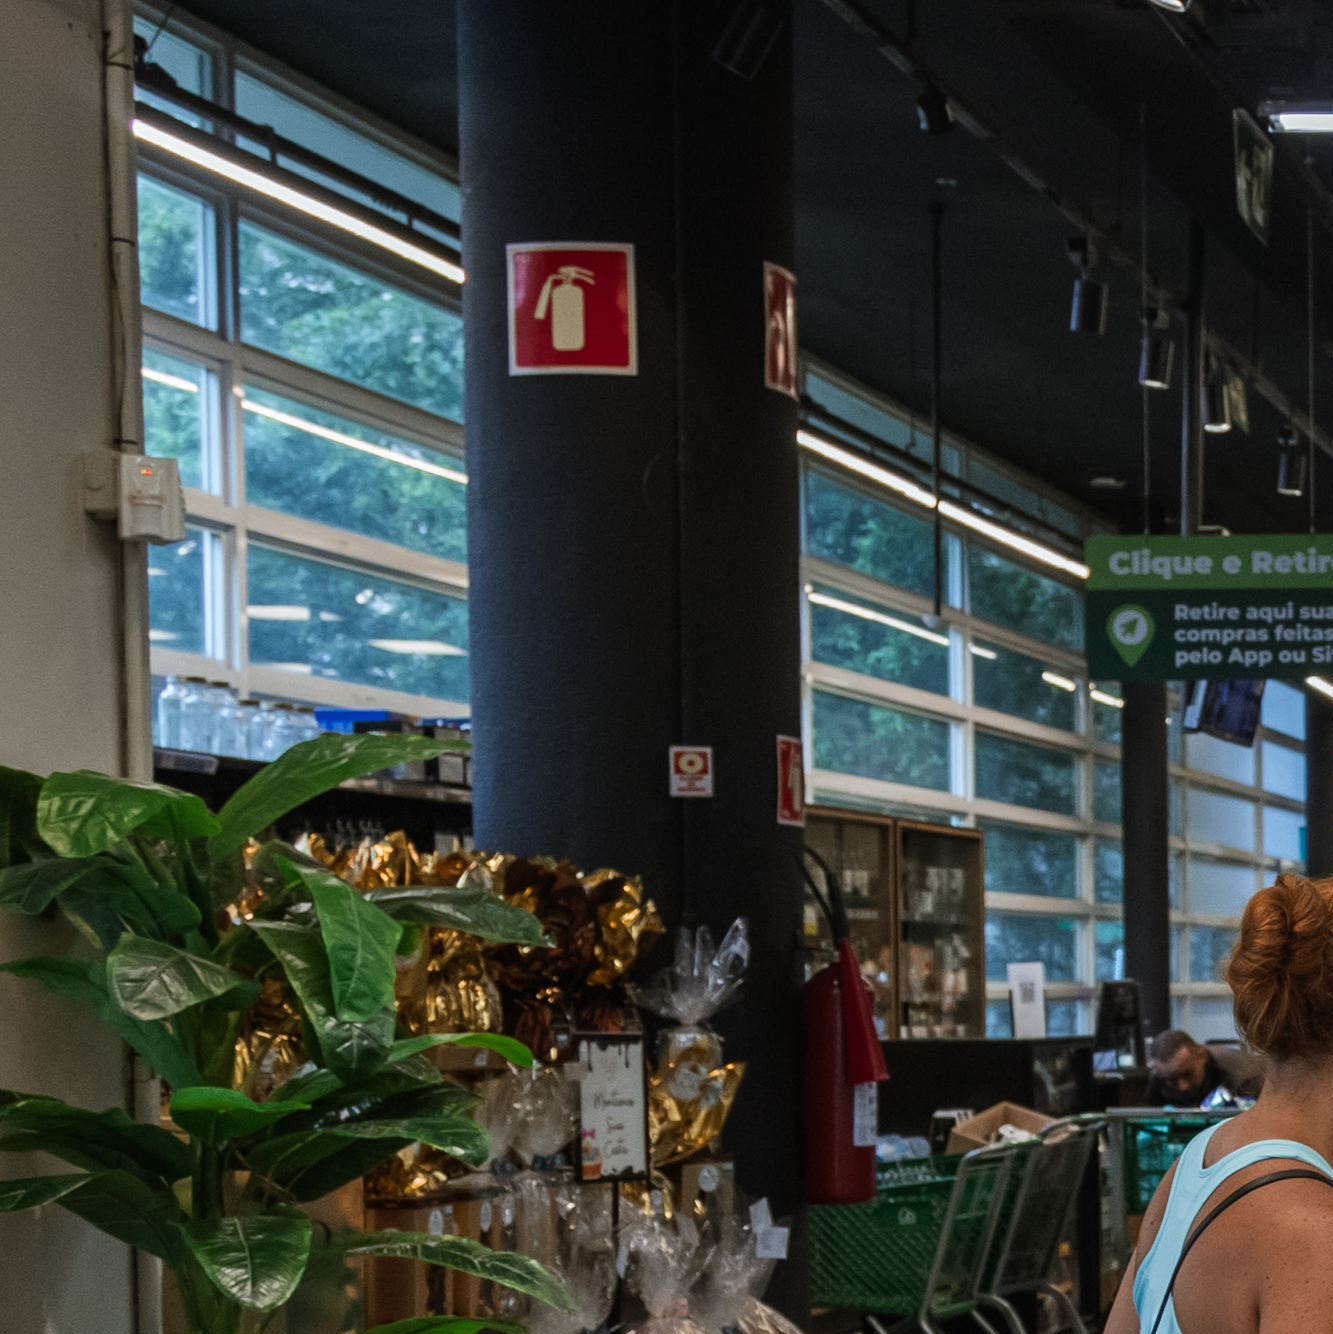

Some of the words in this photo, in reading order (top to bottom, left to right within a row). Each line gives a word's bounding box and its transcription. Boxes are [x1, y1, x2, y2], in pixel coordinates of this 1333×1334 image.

[1109, 549, 1212, 580] Clique
[1223, 554, 1242, 574] e
[1175, 603, 1240, 620] Retire
[1246, 602, 1293, 627] aqui
[1175, 628, 1269, 645] compras
[1175, 649, 1223, 668] pelo
[1228, 648, 1272, 668] App
[1278, 651, 1306, 664] ou
